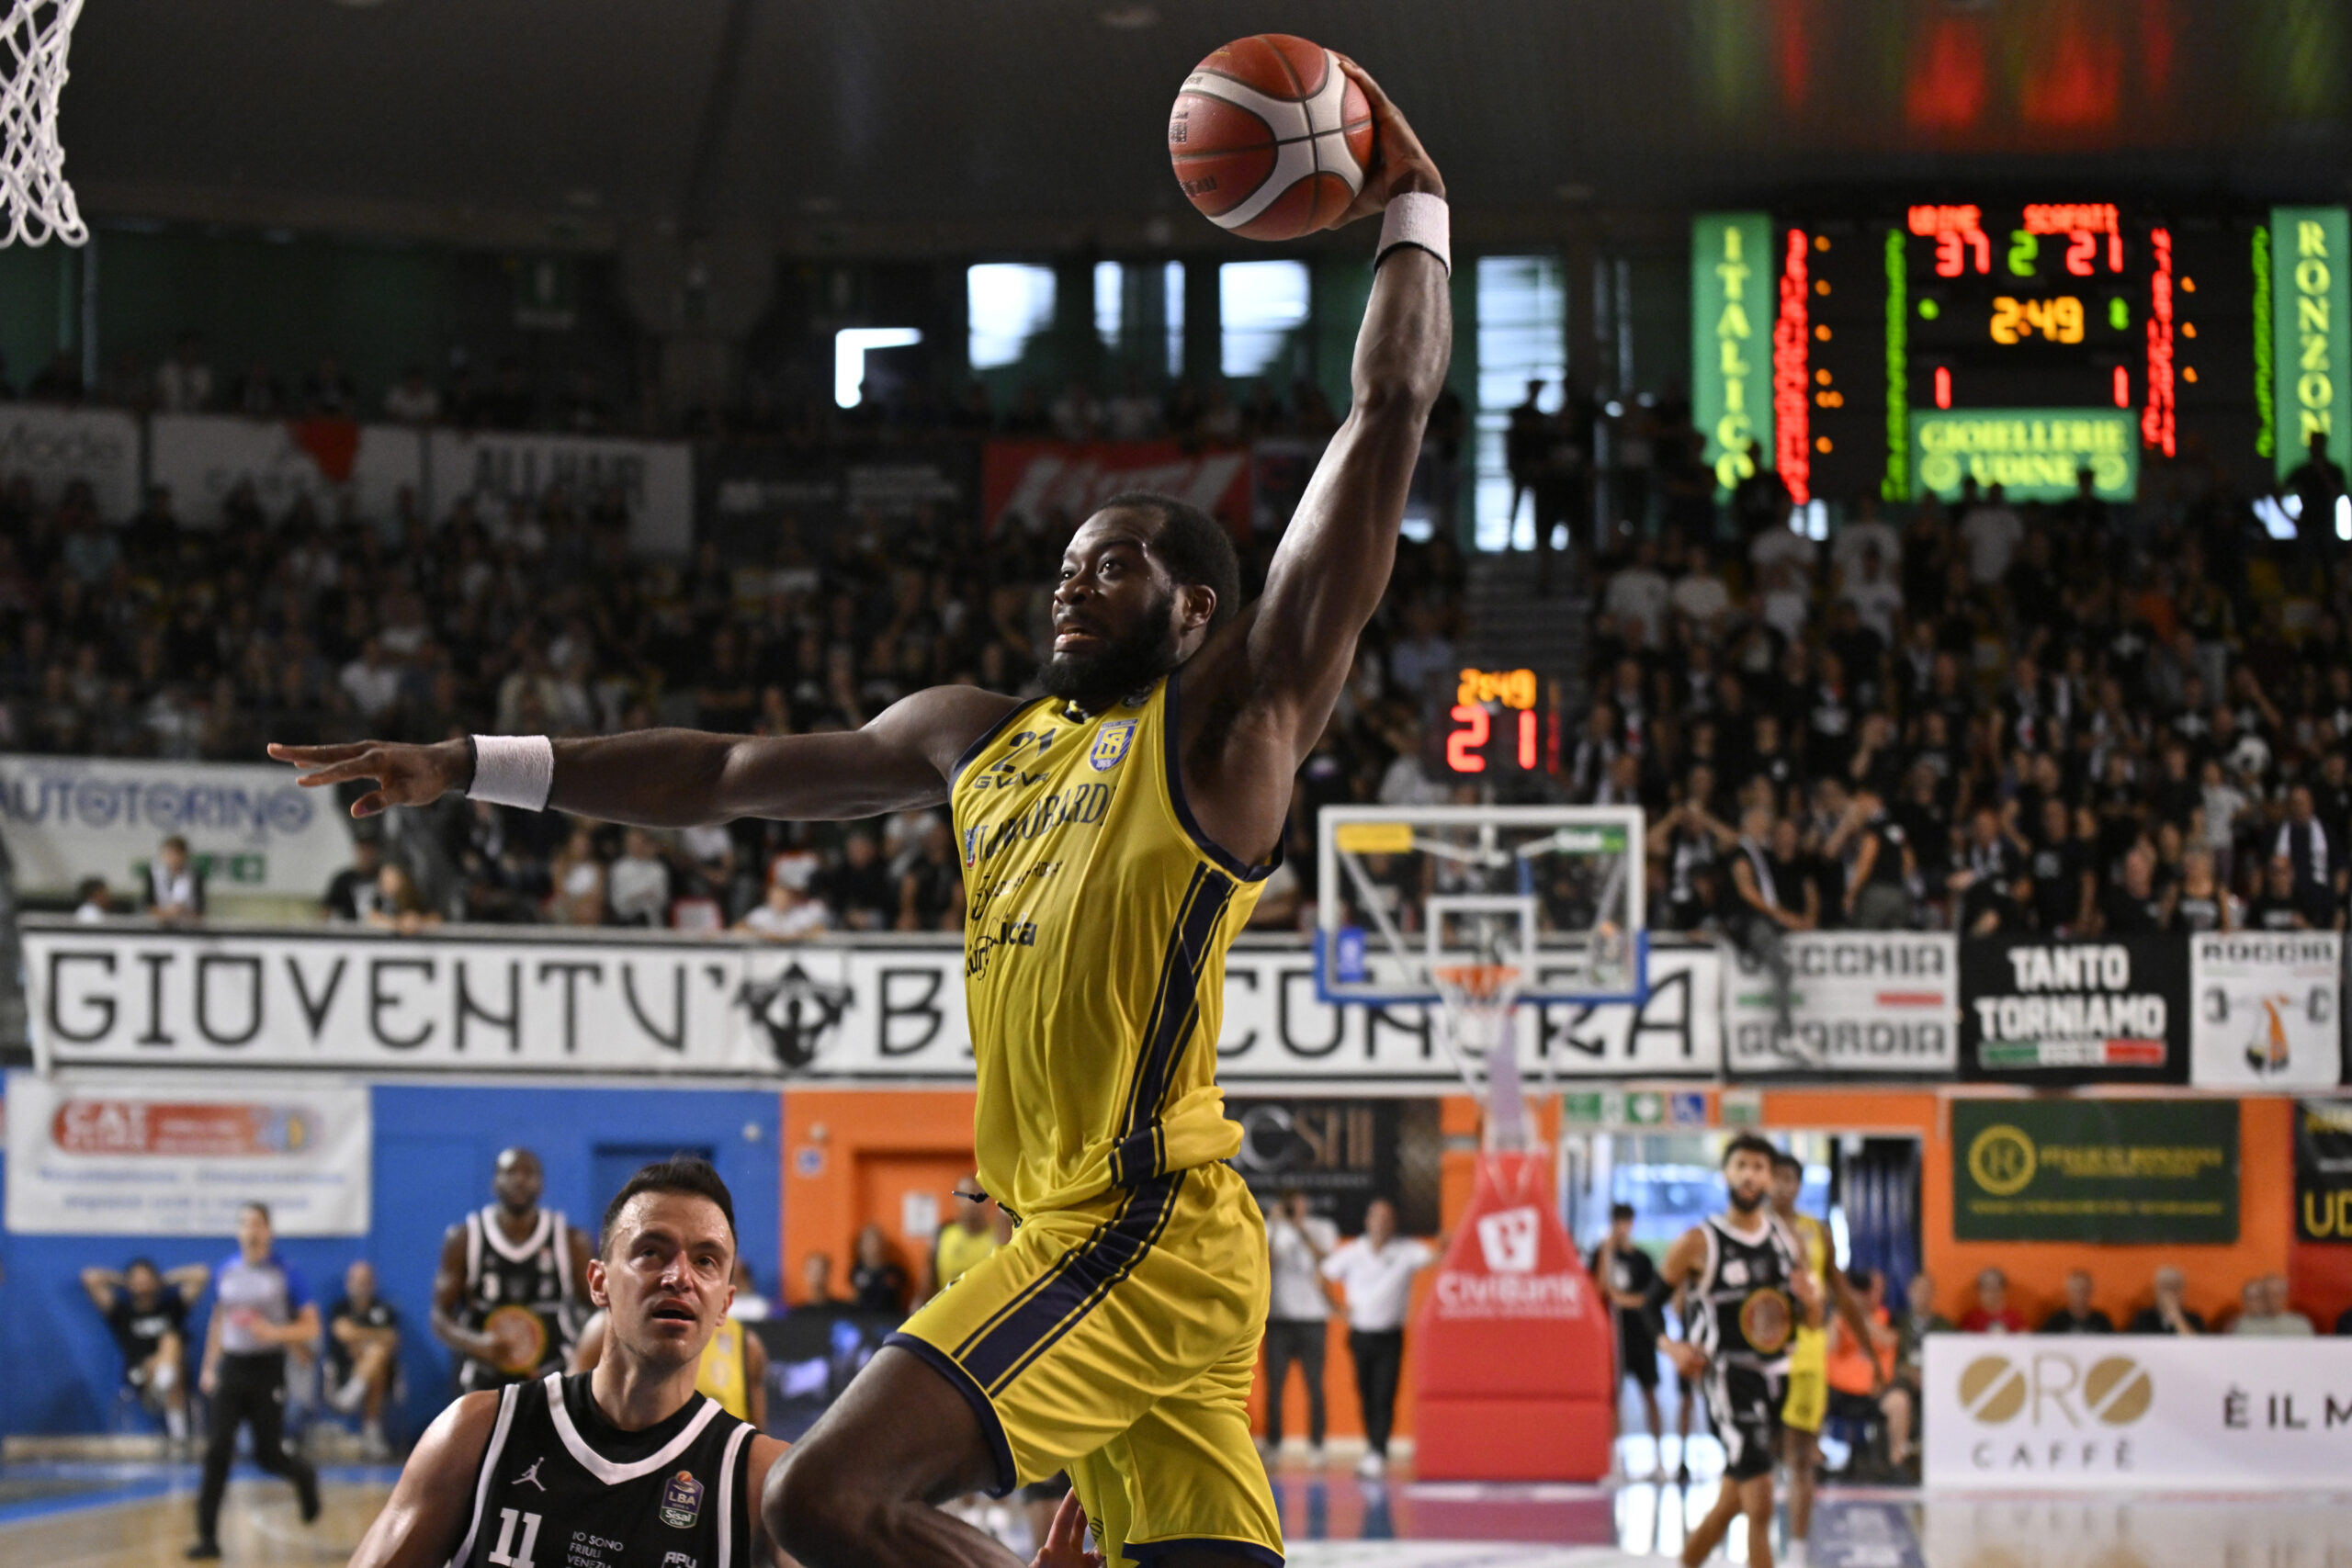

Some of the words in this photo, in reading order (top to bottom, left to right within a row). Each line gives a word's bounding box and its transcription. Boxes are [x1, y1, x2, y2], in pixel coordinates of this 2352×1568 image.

[1936, 230, 1991, 277] 37
[2007, 230, 2039, 276] 2
[2065, 230, 2123, 276] 21
[1990, 296, 2084, 344] 2:49
[1715, 227, 1755, 490] ITALICO
[989, 727, 1057, 773] 21
[1447, 705, 1536, 773] 21
[2007, 944, 2130, 992] TANTO
[1974, 993, 2167, 1041] TORNIAMO
[665, 1509, 692, 1522] Sisal
[669, 1491, 695, 1506] LBA
[488, 1507, 542, 1568] 11
[569, 1542, 601, 1558] FRIULI
[572, 1530, 586, 1541] IO
[588, 1535, 624, 1551] SONO
[664, 1551, 697, 1568] APU
